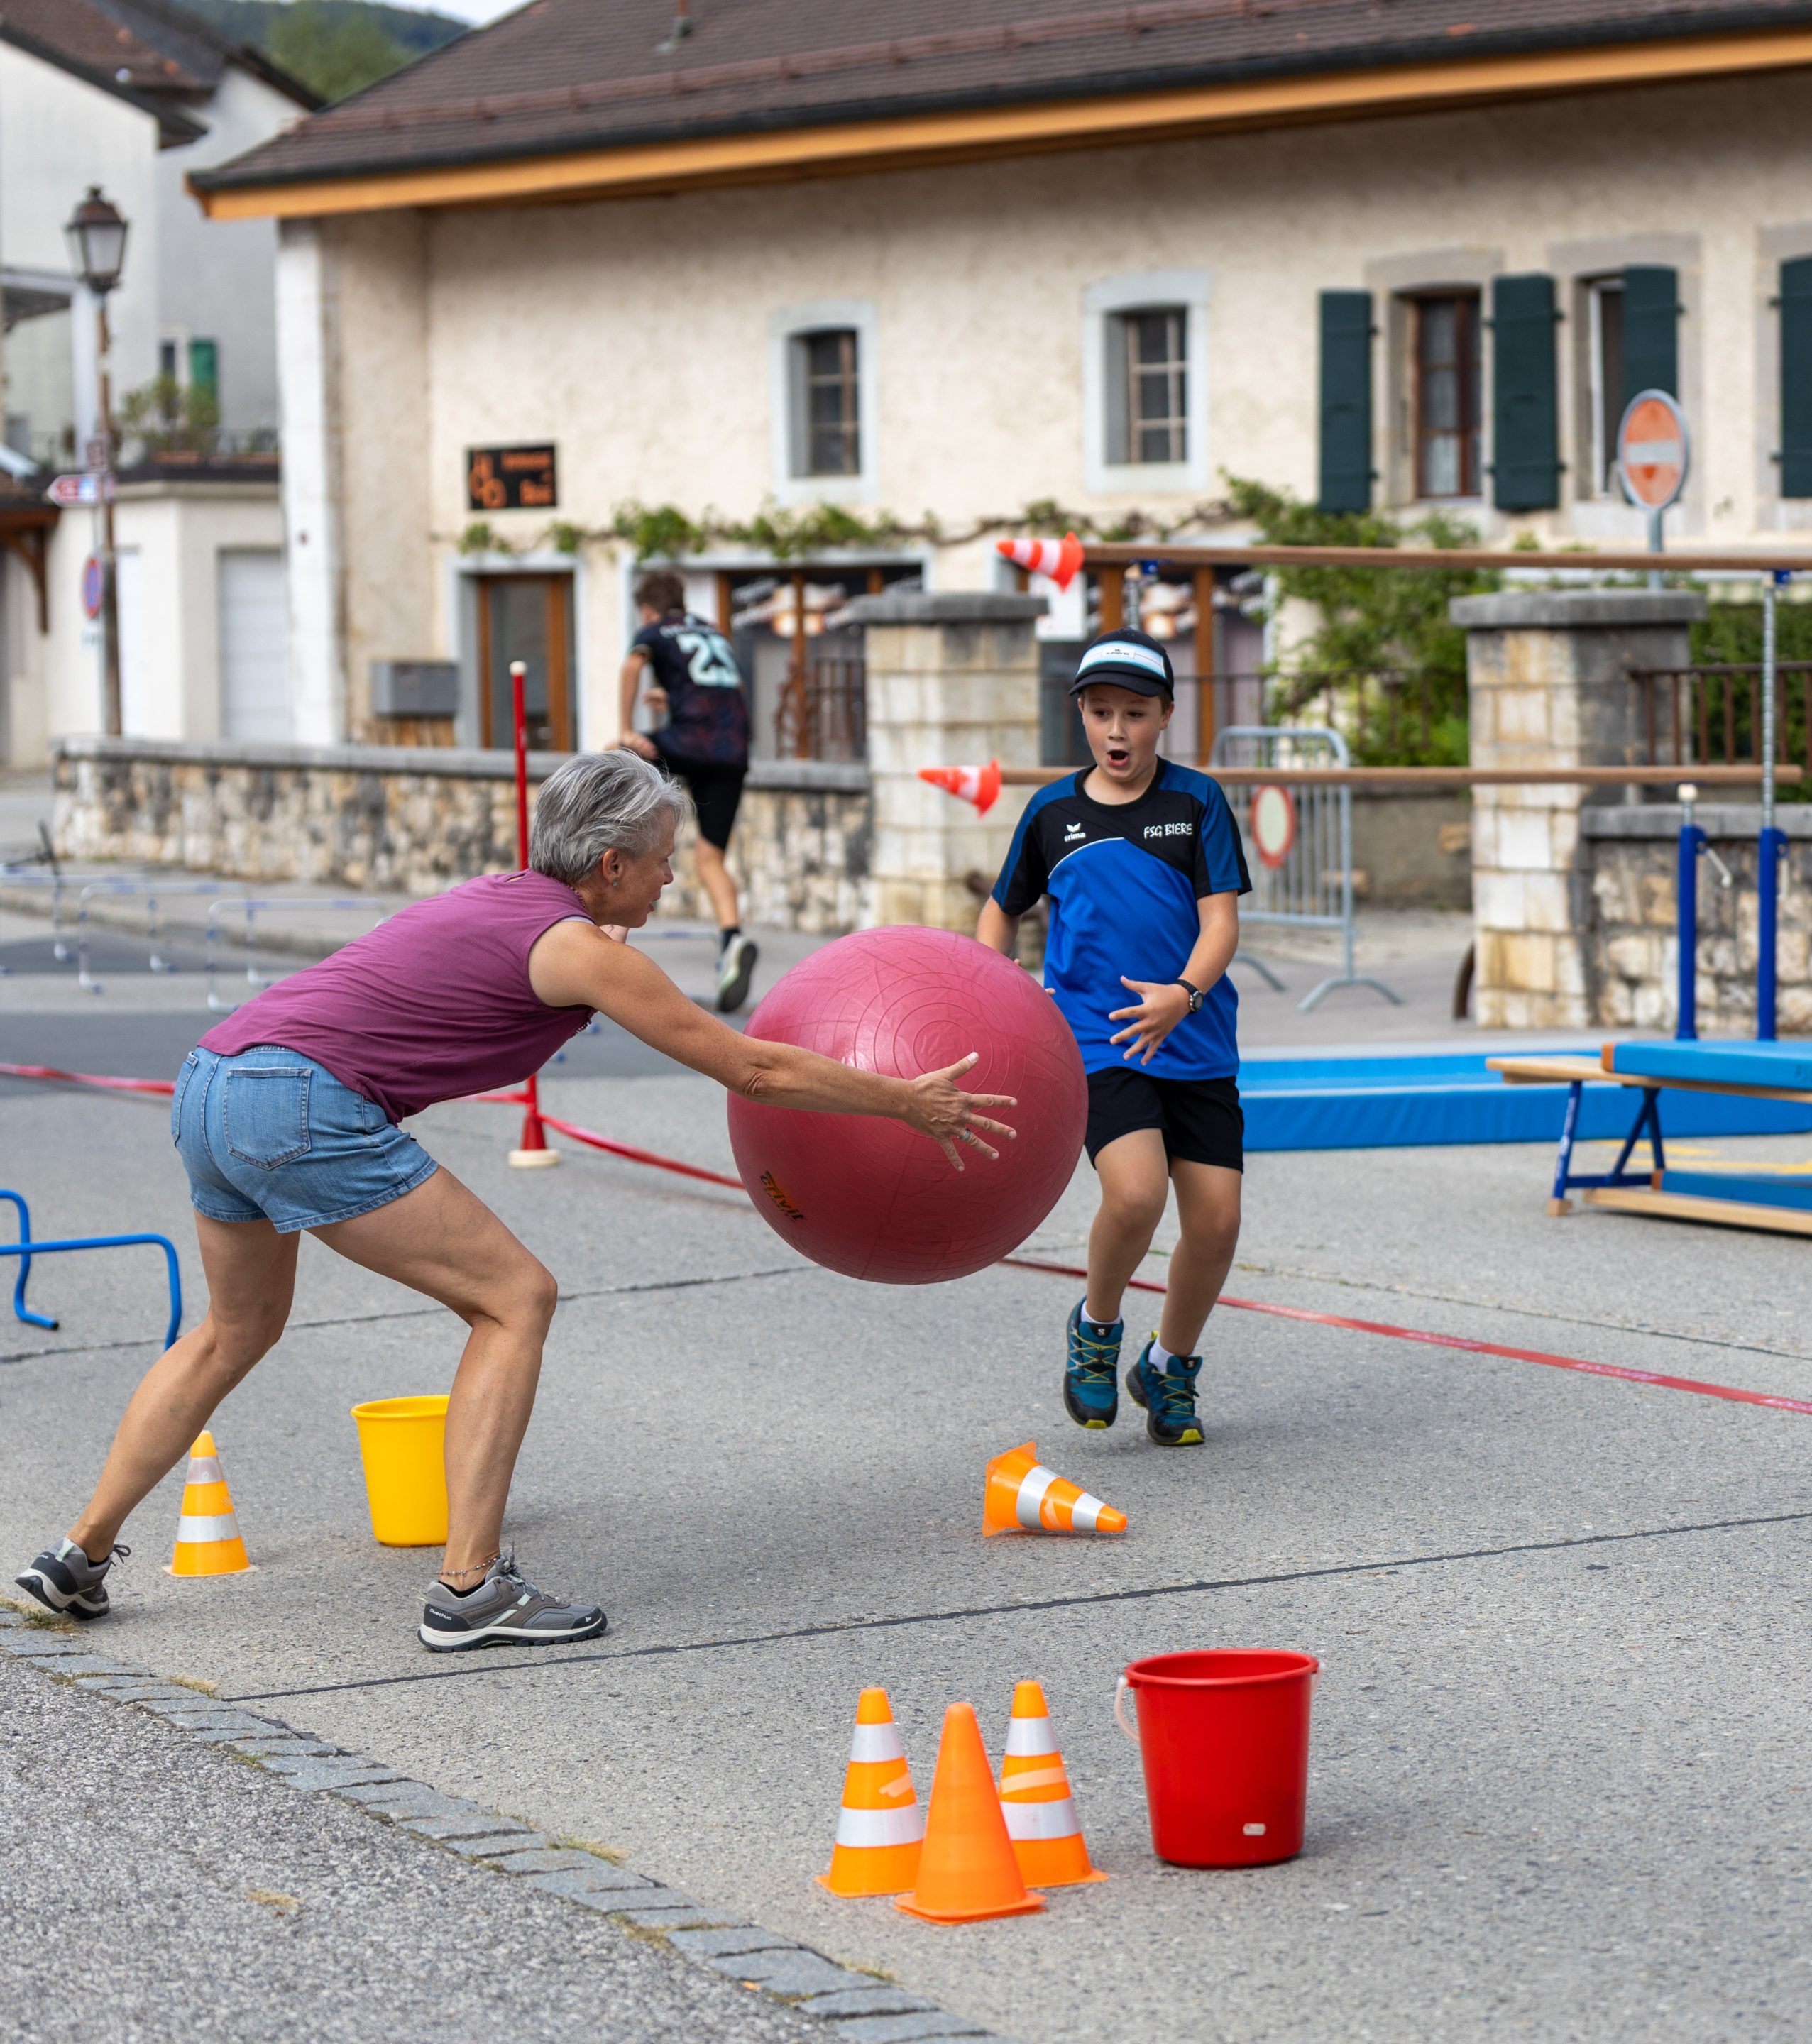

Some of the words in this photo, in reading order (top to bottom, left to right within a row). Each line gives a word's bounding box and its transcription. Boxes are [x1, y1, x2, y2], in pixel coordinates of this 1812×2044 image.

[1064, 832, 1086, 842] erima
[1143, 825, 1163, 839] FSG
[1164, 823, 1192, 837] BIERE
[429, 1608, 452, 1621] Quechua
